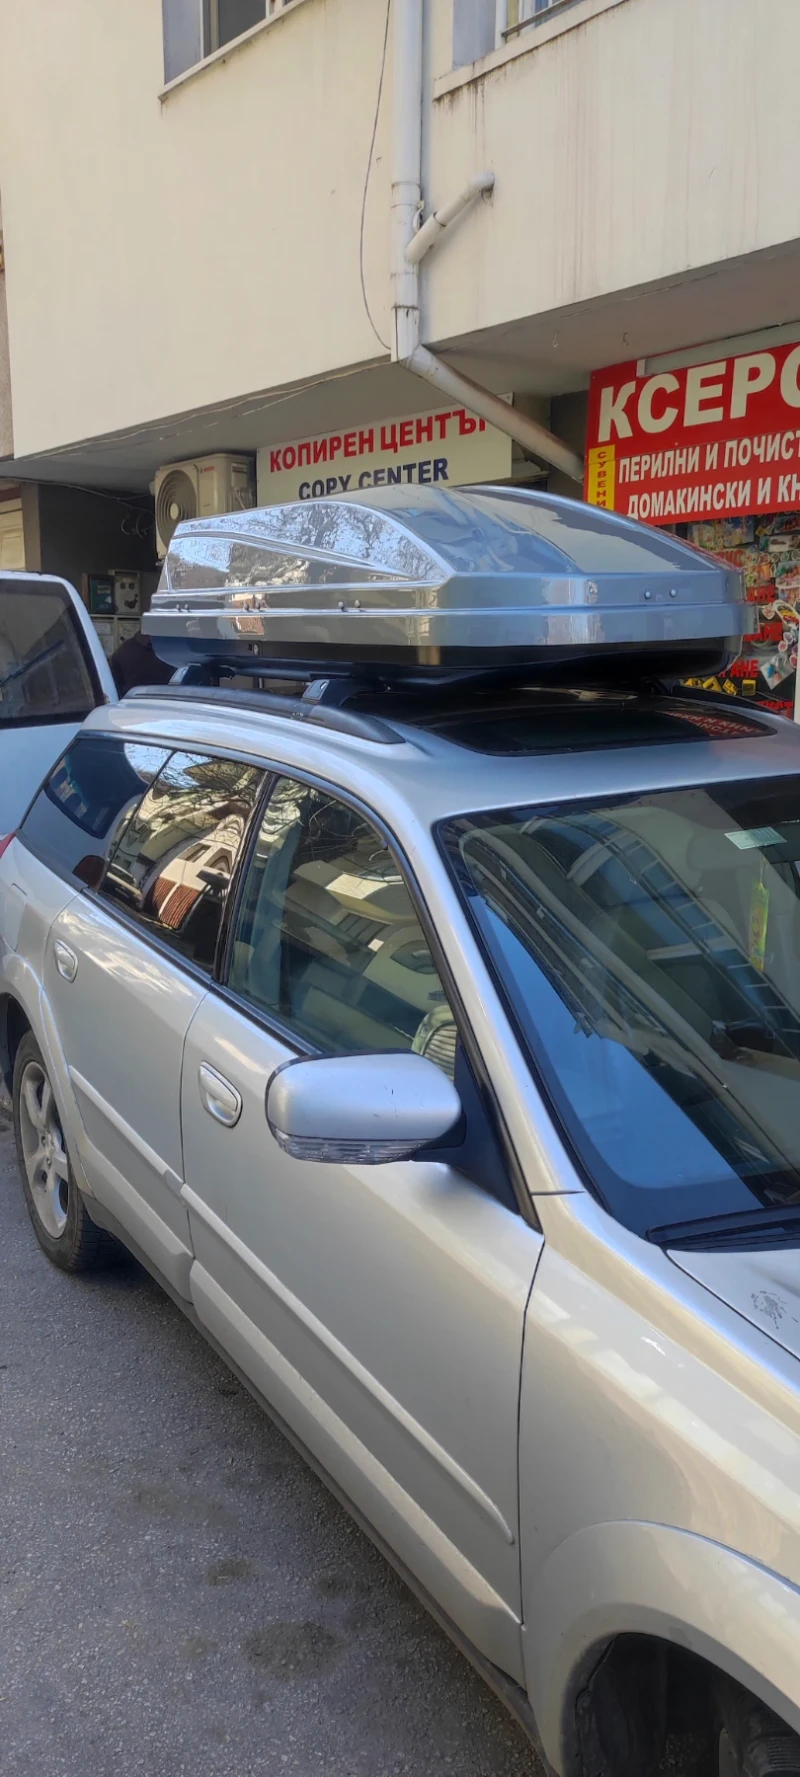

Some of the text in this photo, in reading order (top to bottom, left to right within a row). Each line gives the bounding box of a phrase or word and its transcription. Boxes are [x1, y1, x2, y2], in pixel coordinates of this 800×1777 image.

[269, 428, 374, 473] КОПИРЕН
[618, 446, 700, 484] ПЕРИЛНИ
[705, 443, 719, 471] И
[298, 457, 449, 500] COPY CENTER
[627, 479, 752, 520] ДОМАКИНСКИ
[757, 477, 772, 505] И
